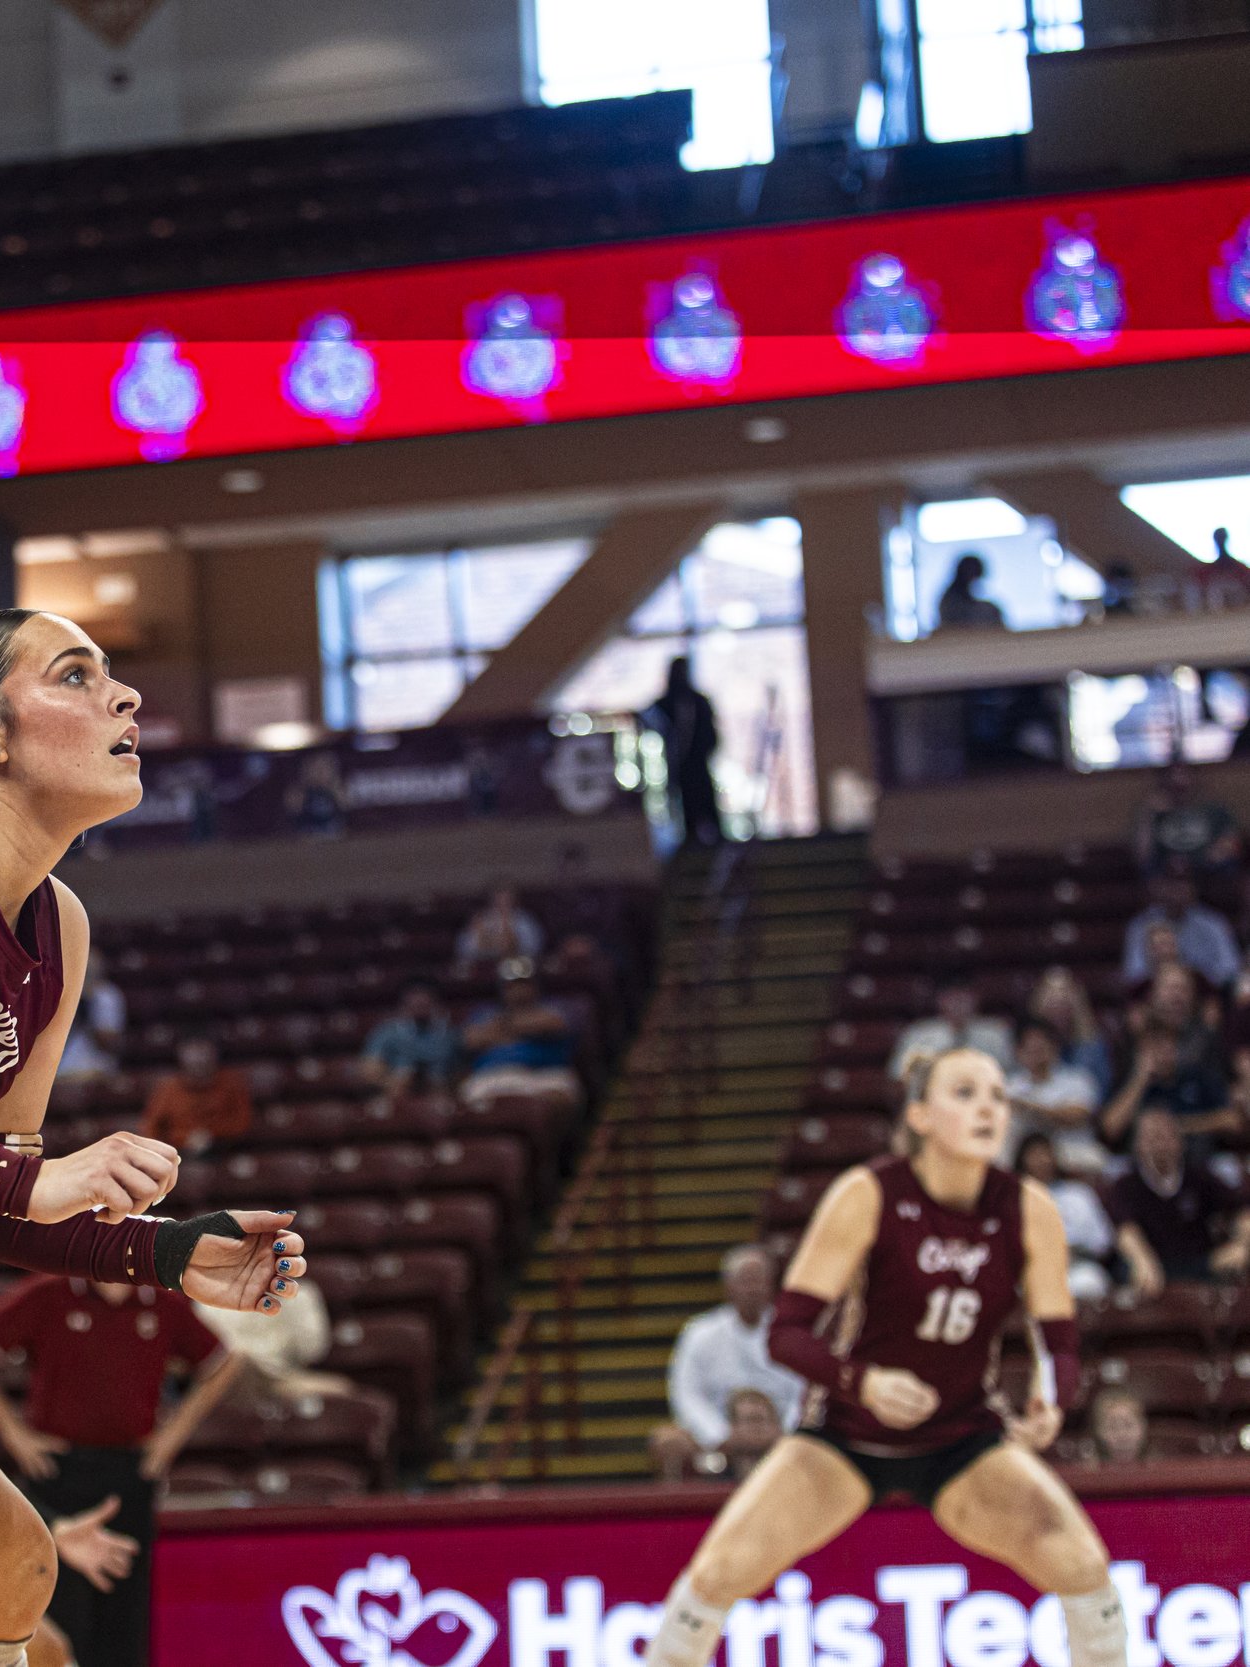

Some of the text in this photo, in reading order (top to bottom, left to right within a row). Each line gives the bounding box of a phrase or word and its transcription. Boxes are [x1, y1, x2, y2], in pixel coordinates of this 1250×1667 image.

[915, 1285, 983, 1345] 16
[507, 1560, 1250, 1667] Hris Tete
